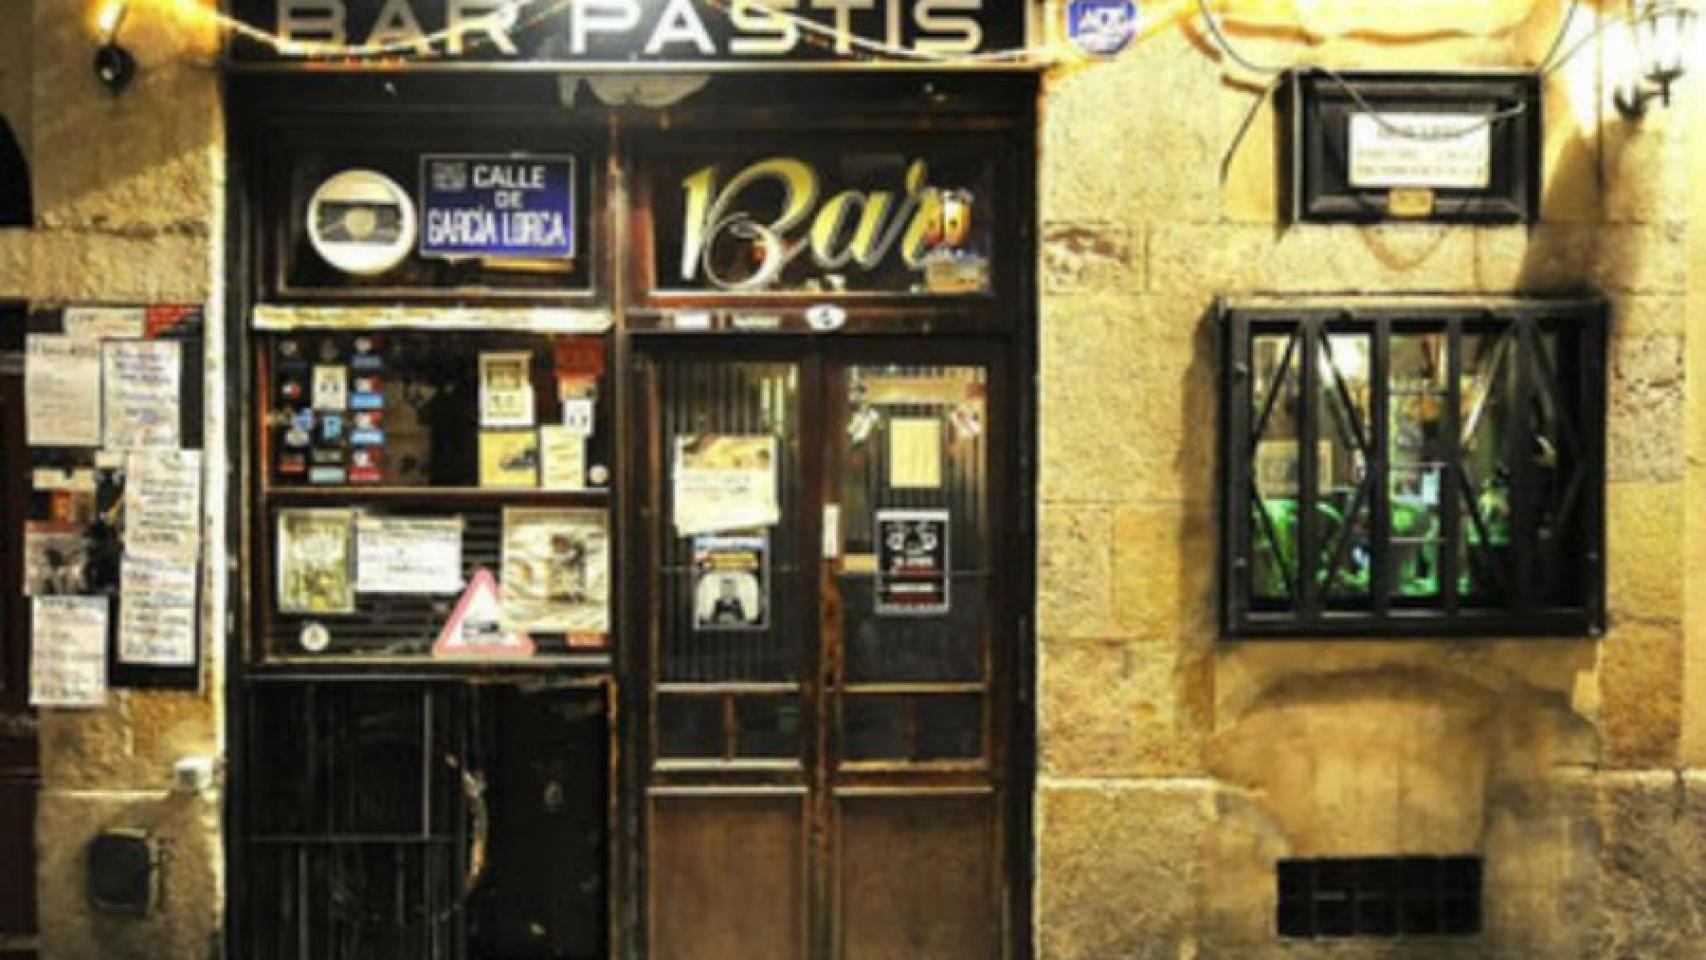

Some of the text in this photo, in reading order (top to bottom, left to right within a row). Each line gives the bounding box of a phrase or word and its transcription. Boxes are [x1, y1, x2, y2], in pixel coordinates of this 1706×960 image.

[278, 0, 983, 54] BAR PASTIS
[472, 164, 546, 188] CALLE
[502, 209, 566, 246] LORCA
[681, 157, 942, 290] Bar
